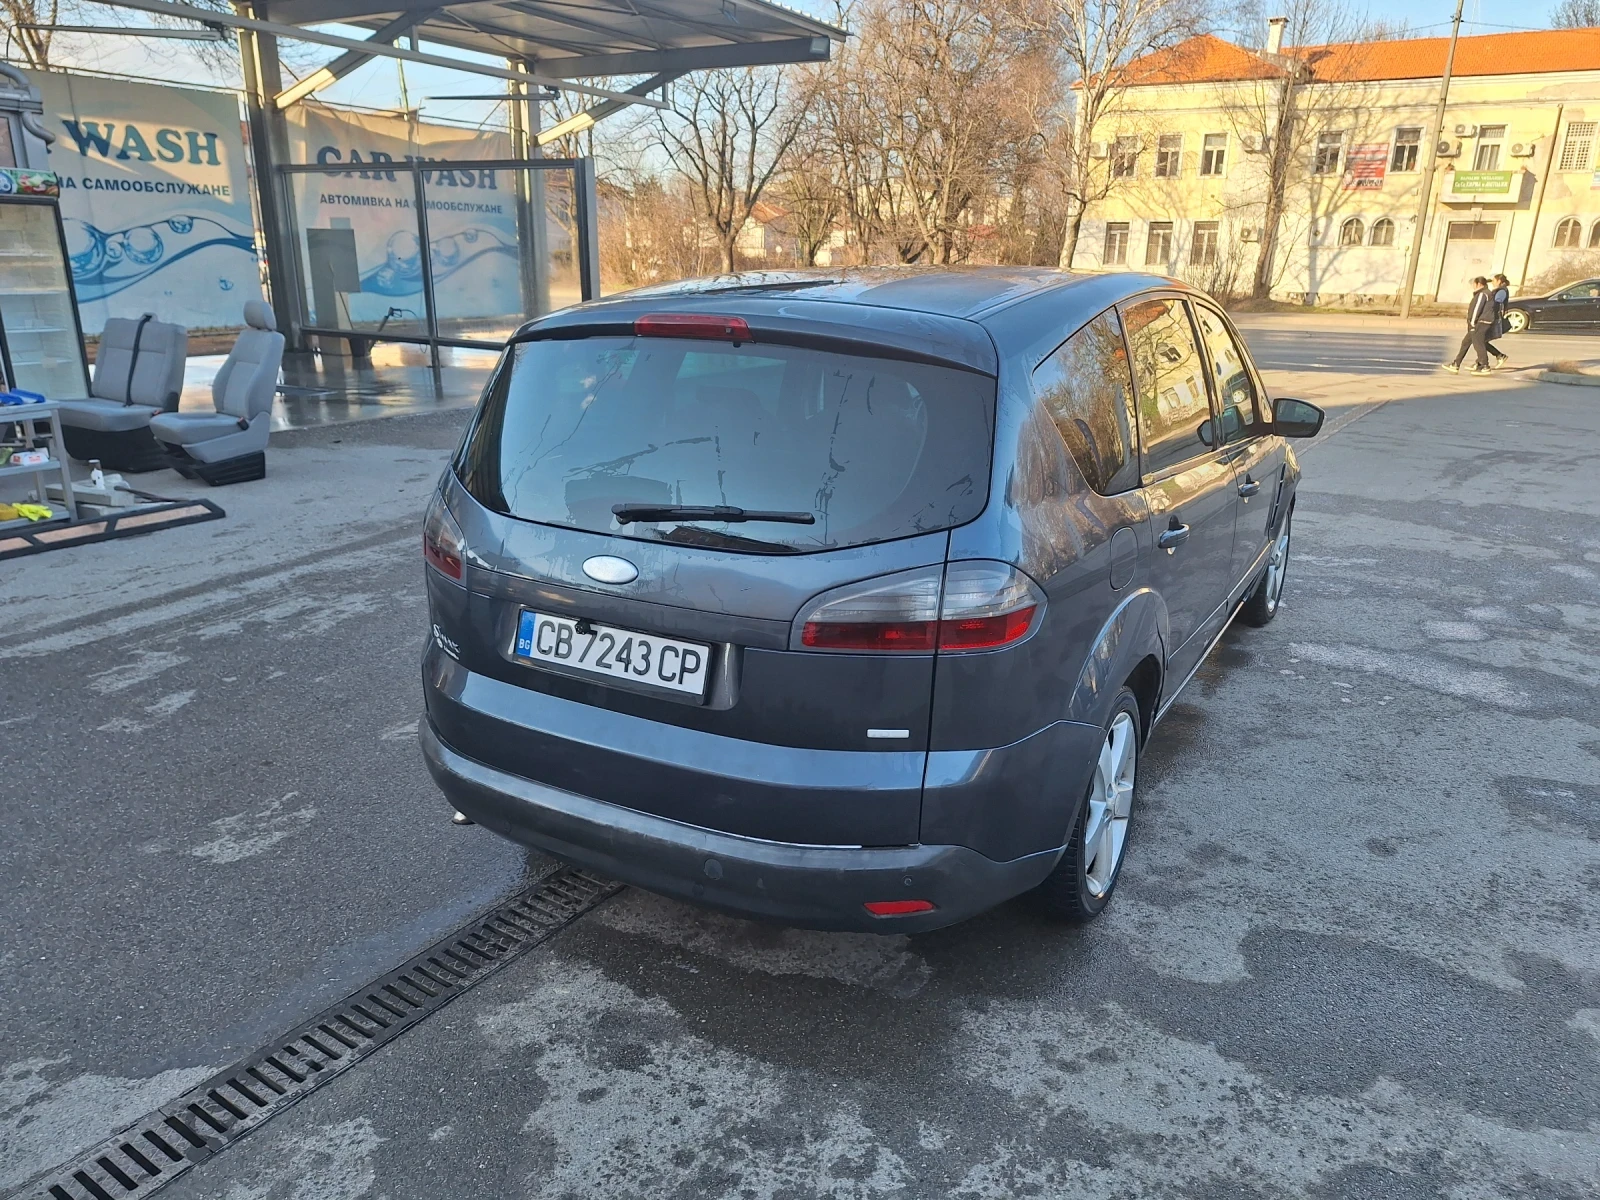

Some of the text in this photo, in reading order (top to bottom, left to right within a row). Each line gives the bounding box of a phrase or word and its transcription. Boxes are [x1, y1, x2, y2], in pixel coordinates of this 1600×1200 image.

[61, 119, 221, 166] WASH
[316, 146, 397, 182] CAR
[82, 177, 231, 197] САМООБСЛУЖАНЕ
[320, 193, 503, 214] АВТОМИВКА НА МООБСЛУЖАНЕ
[518, 620, 701, 685] BG CB 7243 CP
